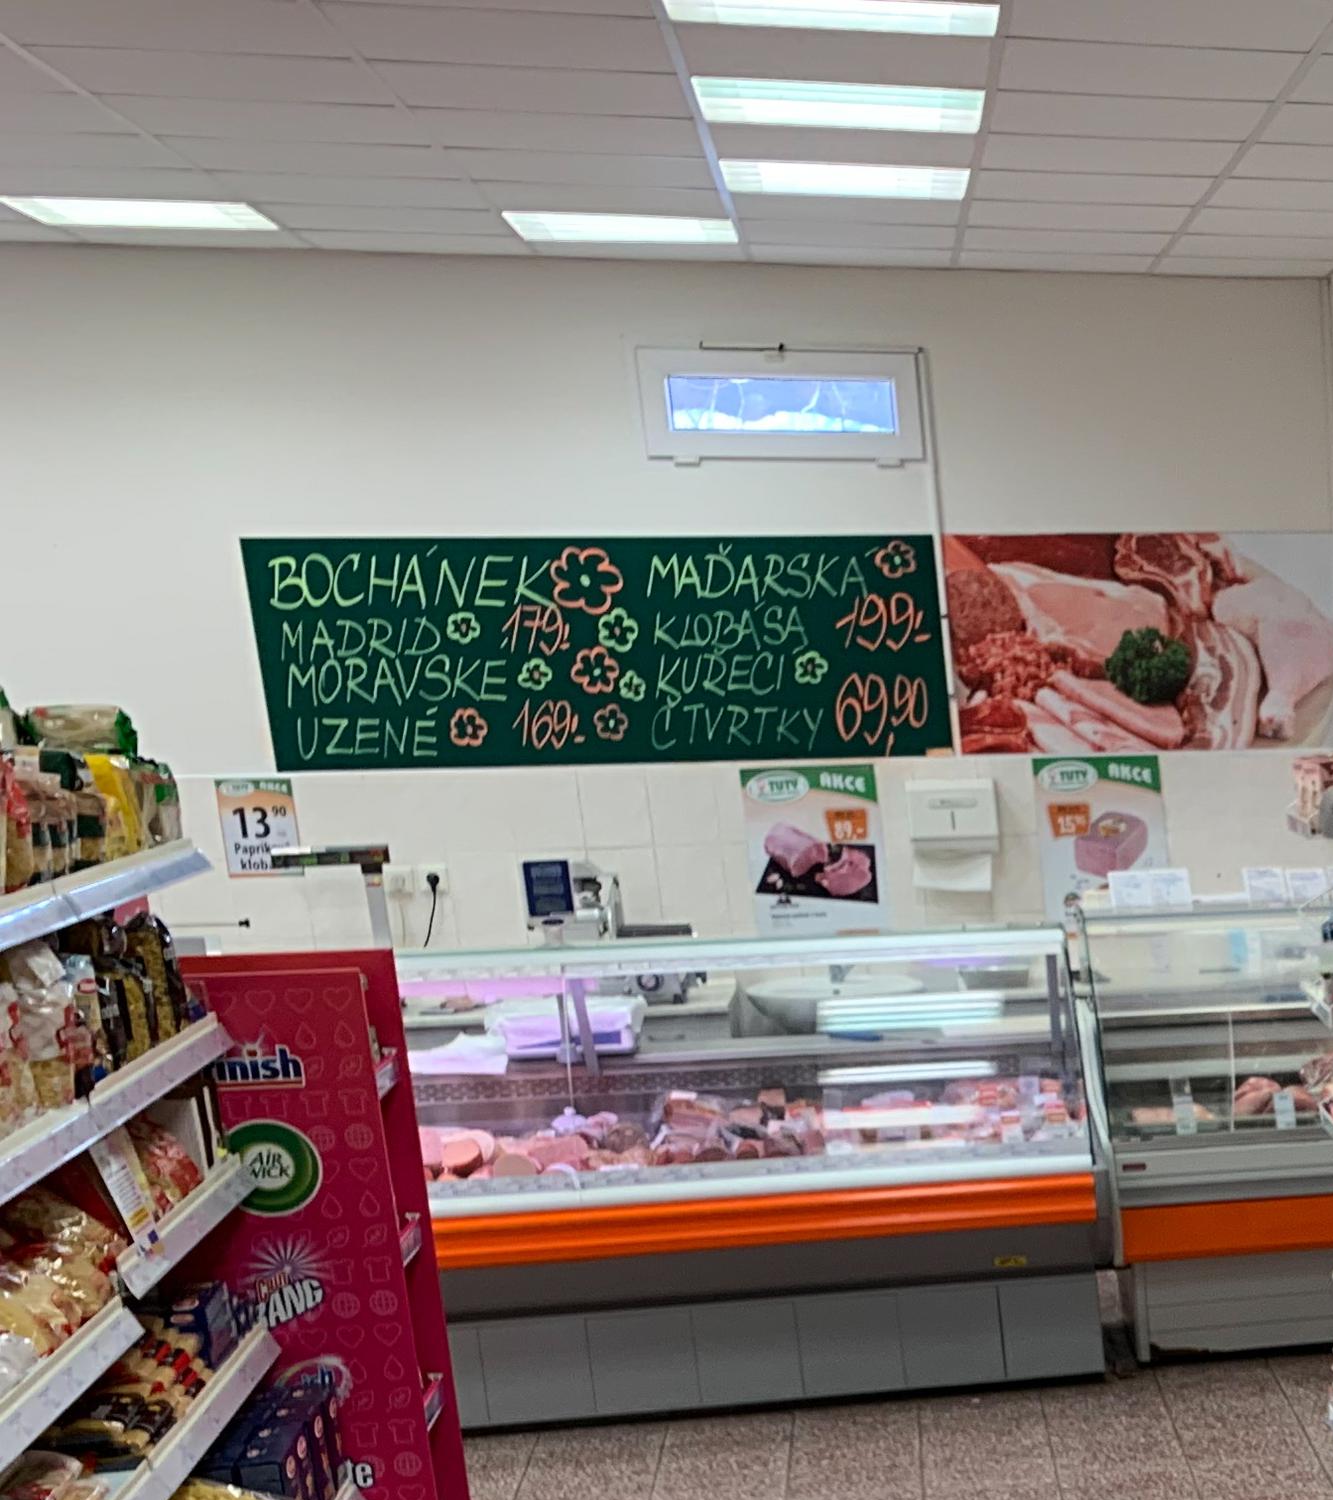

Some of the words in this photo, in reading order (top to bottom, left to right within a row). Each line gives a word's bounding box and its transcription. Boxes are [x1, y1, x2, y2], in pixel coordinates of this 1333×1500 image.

[267, 544, 556, 610] BOCHÁNEK
[281, 616, 441, 663] MADRID
[296, 706, 438, 760] UZENÉ
[819, 771, 866, 793] AKCE
[1107, 762, 1152, 783] AKCE
[232, 806, 271, 839] 13
[272, 805, 287, 817] 90
[215, 1046, 304, 1082] inish
